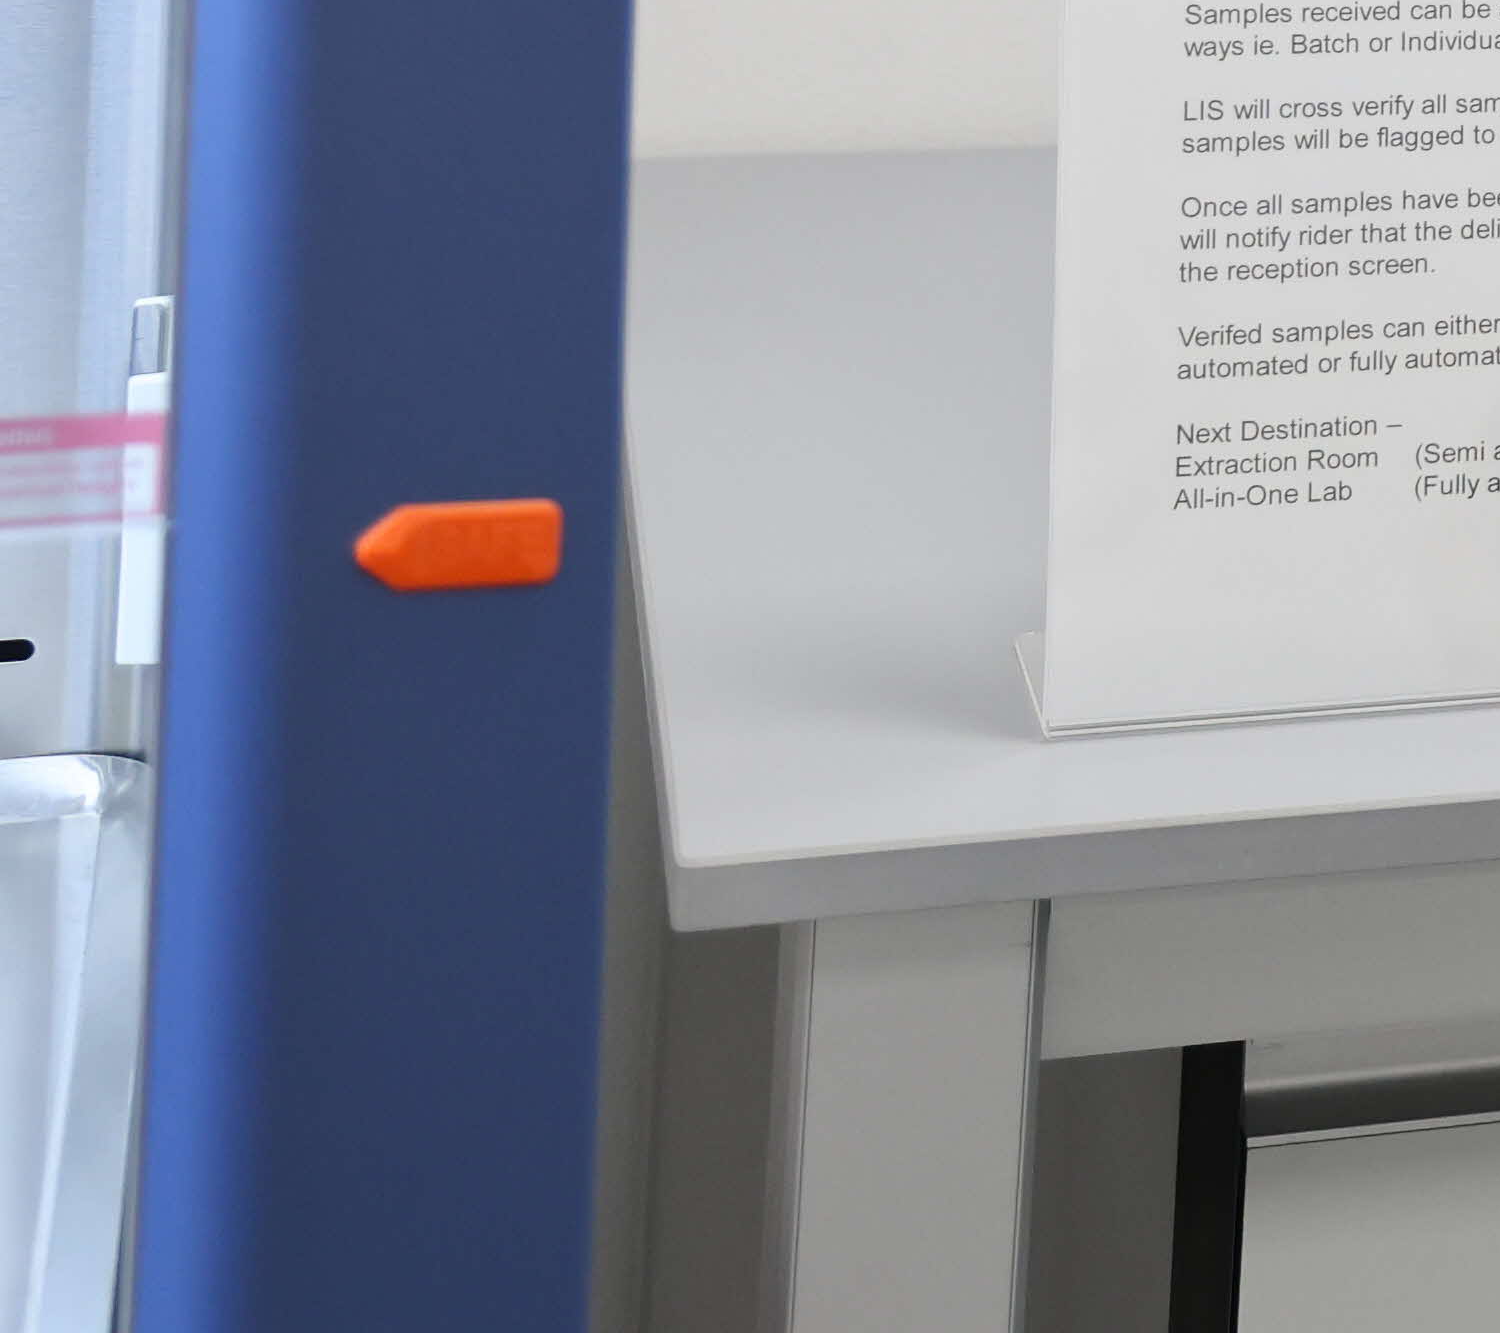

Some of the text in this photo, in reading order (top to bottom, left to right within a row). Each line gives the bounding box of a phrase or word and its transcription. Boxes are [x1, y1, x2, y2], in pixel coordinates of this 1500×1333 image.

[1184, 2, 1293, 30] Samples
[1301, 0, 1401, 23] received
[1410, 3, 1452, 21] can
[1183, 39, 1245, 62] ways
[1253, 34, 1280, 56] ie.
[1291, 32, 1359, 55] Batch
[1368, 36, 1393, 53] or
[1183, 99, 1224, 122] LIS
[1233, 98, 1271, 120] will
[1278, 101, 1343, 119] cross
[1351, 94, 1415, 121] verify
[1421, 93, 1447, 115] all
[1181, 130, 1286, 158] samples
[1293, 128, 1330, 150] will
[1338, 128, 1369, 149] be
[1376, 124, 1464, 153] flagged
[1472, 124, 1496, 145] to
[1180, 196, 1248, 219] Once
[1256, 193, 1283, 216] all
[1291, 190, 1393, 218] samples
[1402, 189, 1459, 211] have
[1179, 228, 1217, 251] will
[1225, 225, 1292, 253] notify
[1299, 224, 1354, 246] rider
[1360, 222, 1407, 244] that
[1414, 220, 1453, 242] the
[1178, 256, 1436, 285] the reception screen.
[1177, 322, 1262, 348] Verifed
[1271, 319, 1374, 347] samples
[1382, 321, 1425, 339] can
[1176, 353, 1309, 380] automated
[1317, 356, 1342, 374] or
[1348, 349, 1398, 376] fully
[1176, 422, 1232, 446] Next
[1240, 415, 1378, 442] Destination
[1175, 452, 1297, 478] Extraction
[1307, 448, 1379, 471] Room
[1415, 440, 1485, 470] (Semi
[1172, 484, 1299, 510] All-in-One
[1307, 480, 1353, 503] Lab
[1414, 472, 1481, 502] (Fully
